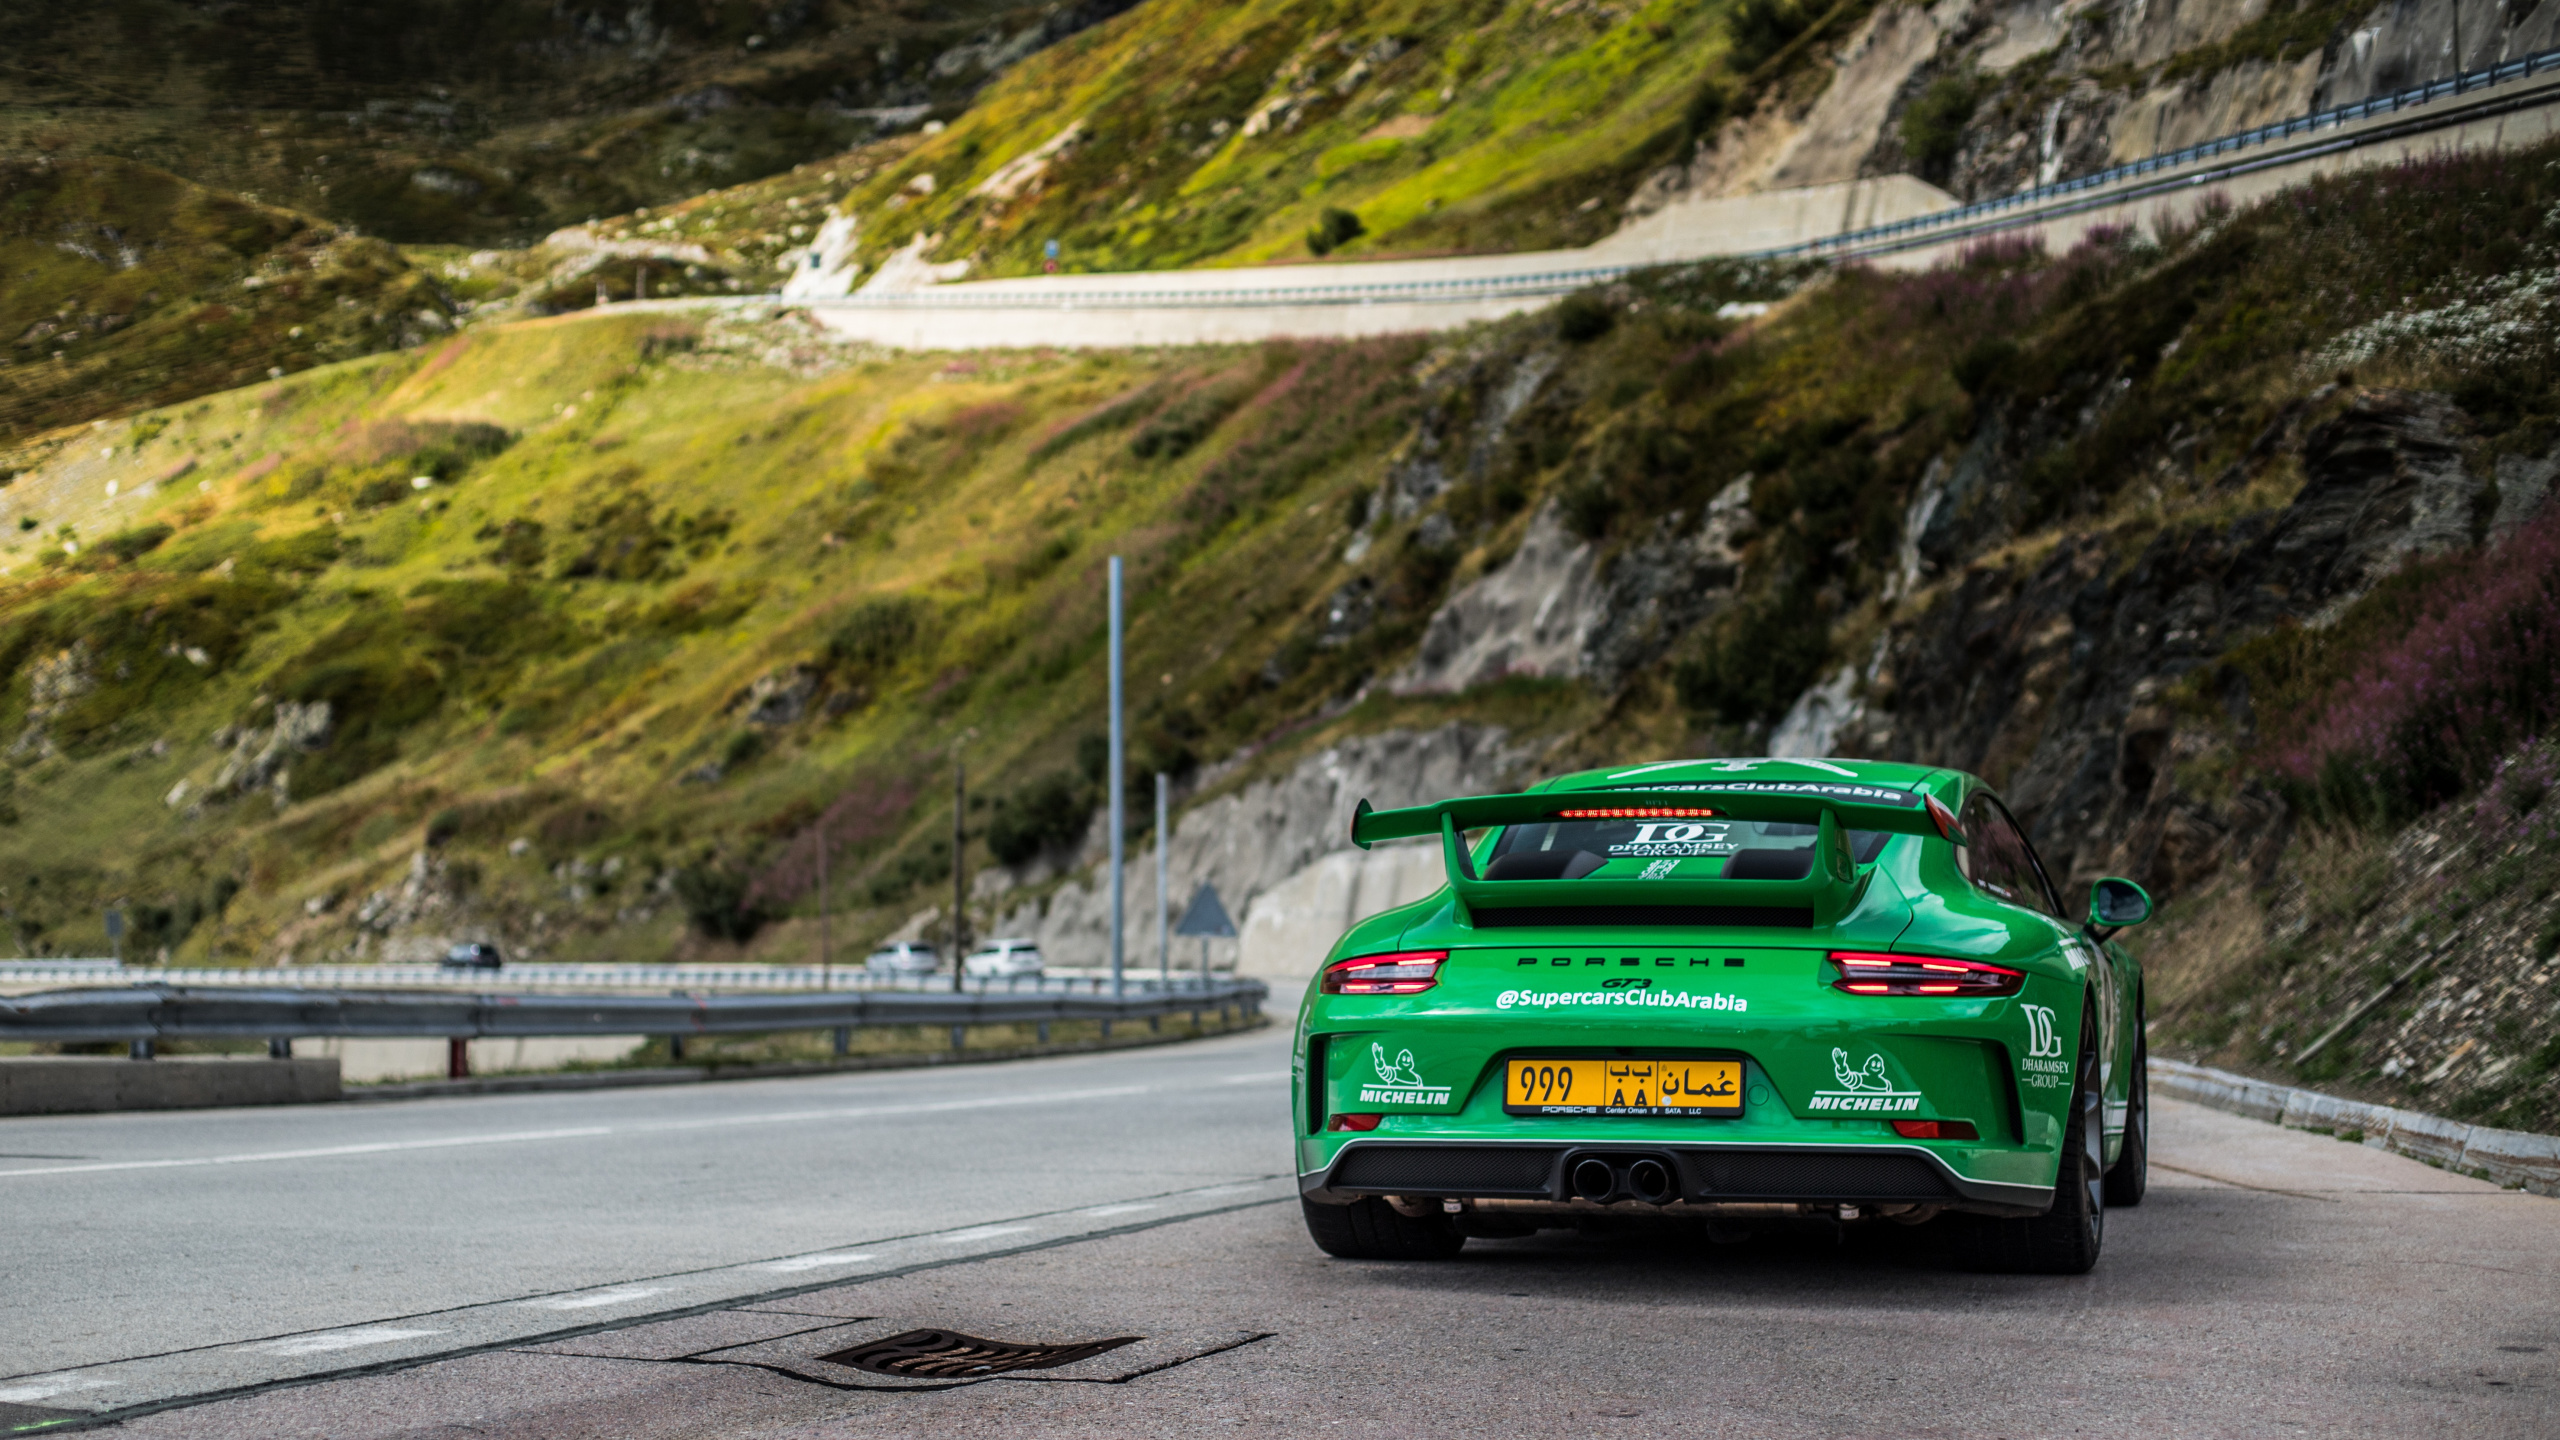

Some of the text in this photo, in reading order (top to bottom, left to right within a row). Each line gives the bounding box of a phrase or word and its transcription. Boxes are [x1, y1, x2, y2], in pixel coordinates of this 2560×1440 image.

[1608, 843, 1739, 852] DHARAMSEY
[1633, 848, 1706, 857] GROUP
[1517, 957, 1745, 967] PORSCHE
[1601, 978, 1653, 989] GT3
[1496, 989, 1748, 1012] @SupercarsClubArabia
[2022, 1058, 2069, 1074] DHARAMSEY
[1521, 1066, 1573, 1102] 999
[2031, 1074, 2059, 1089] GROUP
[1359, 1089, 1451, 1105] MICHELIN
[1808, 1096, 1920, 1112] MICHELIN
[1541, 1106, 1597, 1114] PORSCHE
